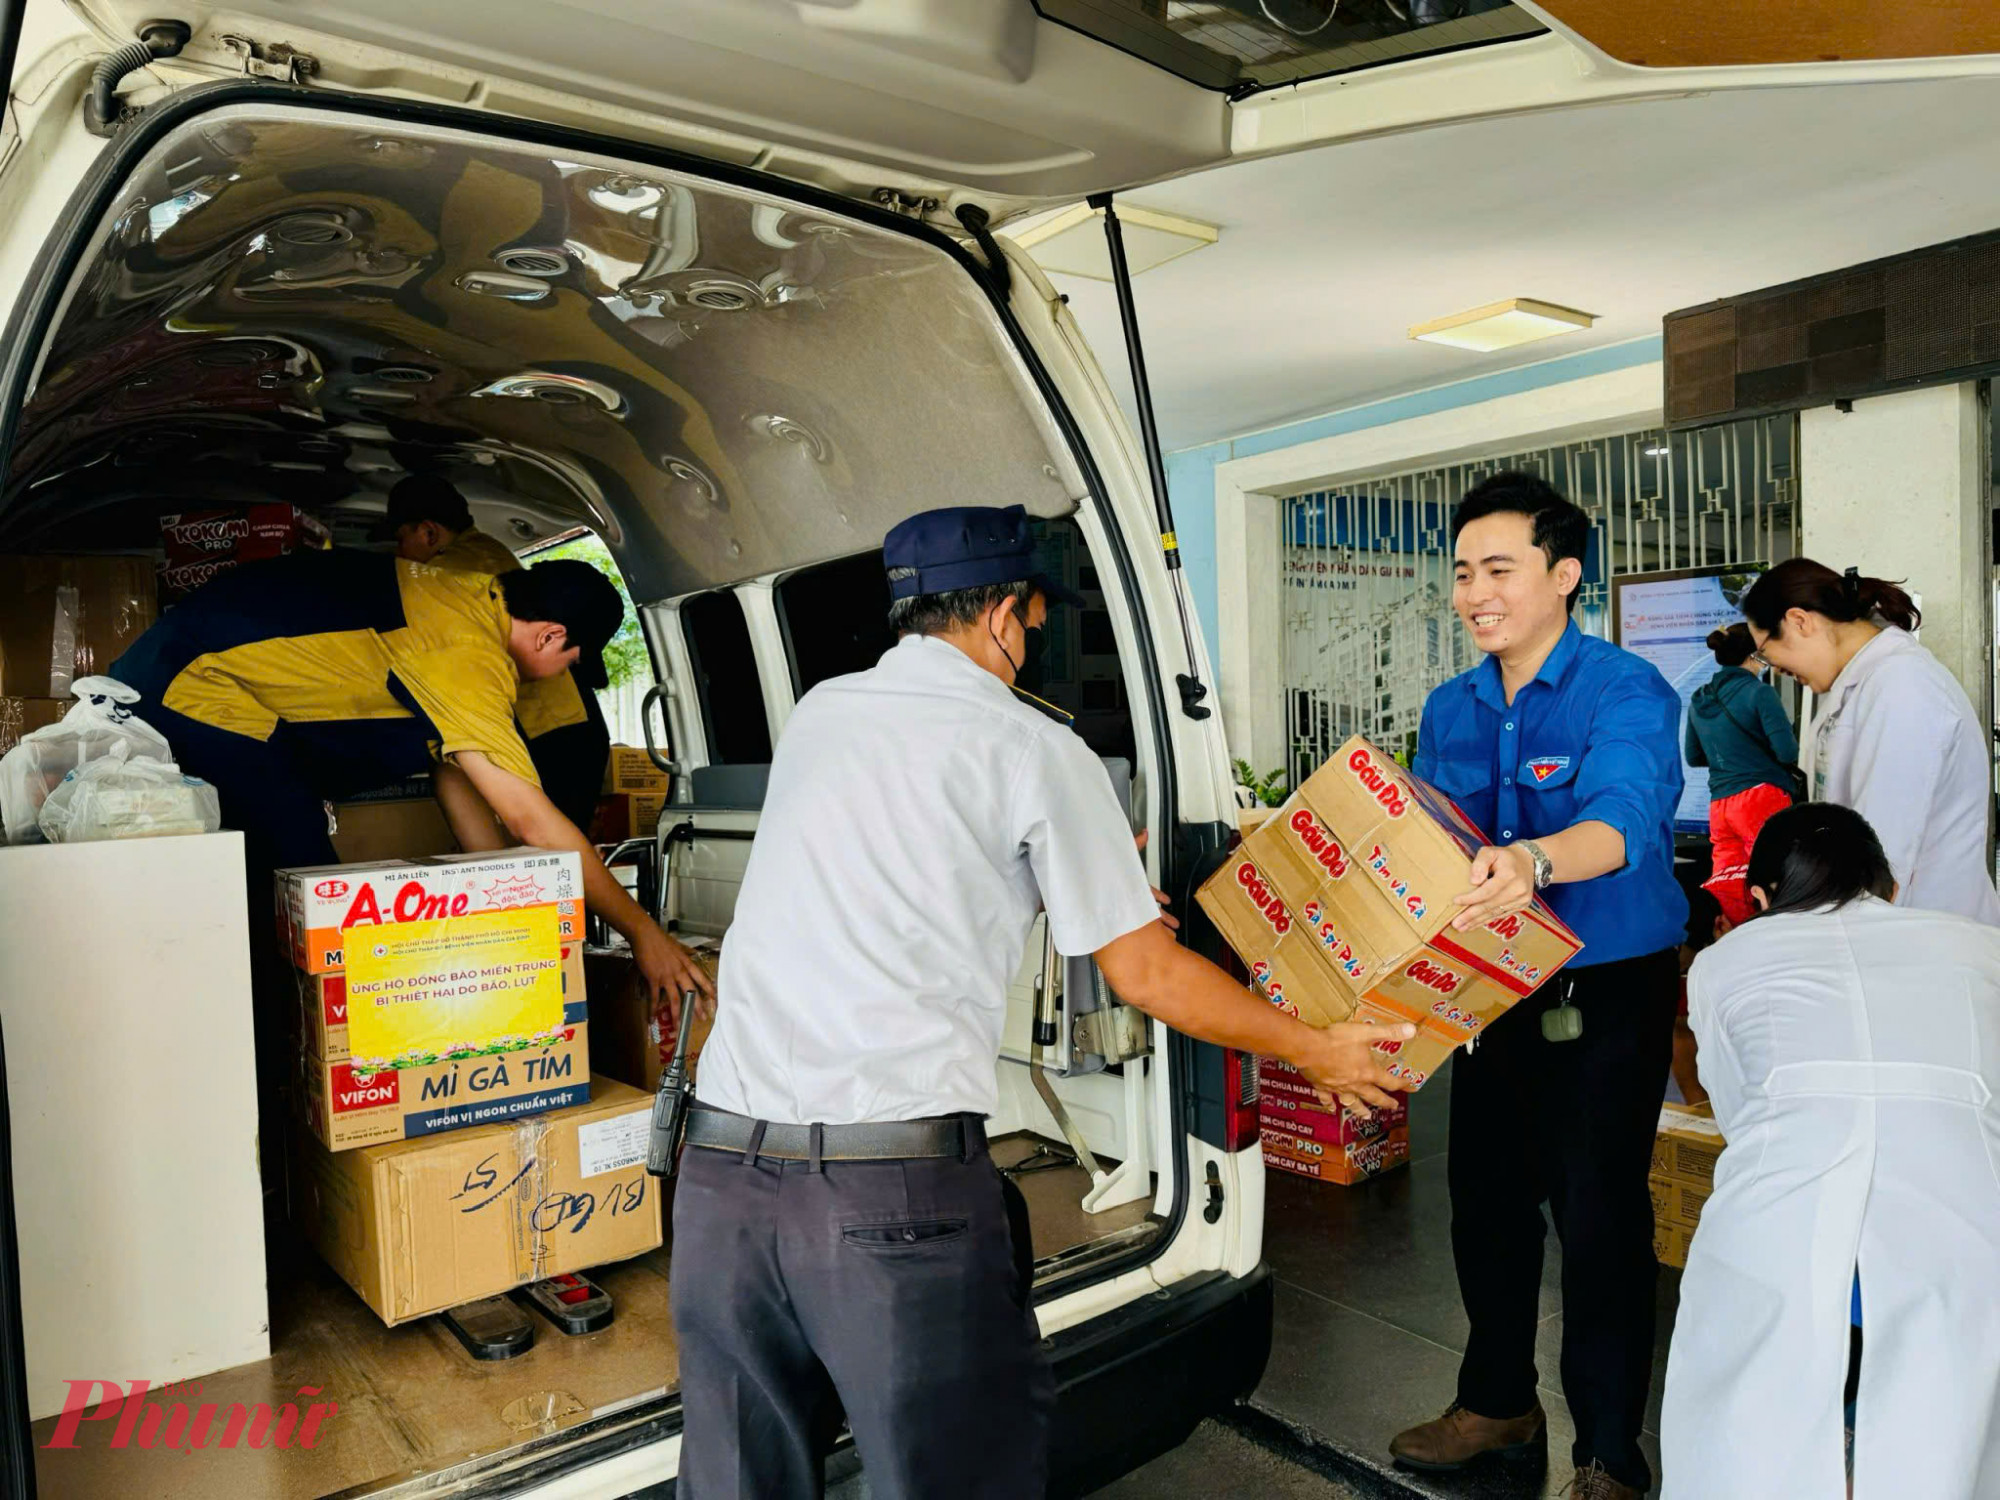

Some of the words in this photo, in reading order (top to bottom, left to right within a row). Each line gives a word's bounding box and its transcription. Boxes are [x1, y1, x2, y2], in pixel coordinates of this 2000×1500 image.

[174, 519, 250, 544] KOKOMI
[205, 539, 232, 551] PRO
[478, 863, 515, 872] NOODLES
[1367, 844, 1391, 878] Tôm
[1390, 879, 1408, 898] và
[1406, 895, 1427, 920] Gà
[340, 881, 469, 929] A-One
[1305, 901, 1322, 926] Gà
[384, 979, 404, 991] HỘ
[408, 973, 447, 987] ĐỒNG
[450, 969, 478, 982] BÀO
[481, 964, 512, 978] MIỀN
[515, 959, 557, 973] TRUNG
[1253, 961, 1271, 984] Gà
[376, 996, 389, 1007] BỊ
[393, 991, 429, 1004] THIỆT
[459, 985, 477, 995] DO
[514, 976, 537, 988] LỤT
[421, 1063, 459, 1102] MÌ
[468, 1056, 510, 1091] GÀ
[523, 1048, 571, 1082] TÍM
[1278, 1061, 1297, 1074] PRO
[340, 1088, 393, 1106] VIFON
[1271, 1080, 1292, 1091] CHUA
[1293, 1084, 1311, 1095] NAM
[426, 1113, 459, 1129] VIFON
[461, 1111, 473, 1123] VỊ
[475, 1105, 507, 1120] NGON
[549, 1092, 573, 1106] VIỆT
[1276, 1098, 1296, 1110] PRO
[1272, 1118, 1285, 1128] CHI
[1286, 1121, 1297, 1131] BÒ
[1298, 1125, 1313, 1136] CAY
[1260, 1128, 1293, 1149] OKOMI
[1296, 1139, 1323, 1155] PRO
[1263, 1152, 1280, 1165] TÔM
[1280, 1158, 1296, 1169] CAY
[1297, 1162, 1308, 1172] SA
[1308, 1162, 1320, 1175] TẾ
